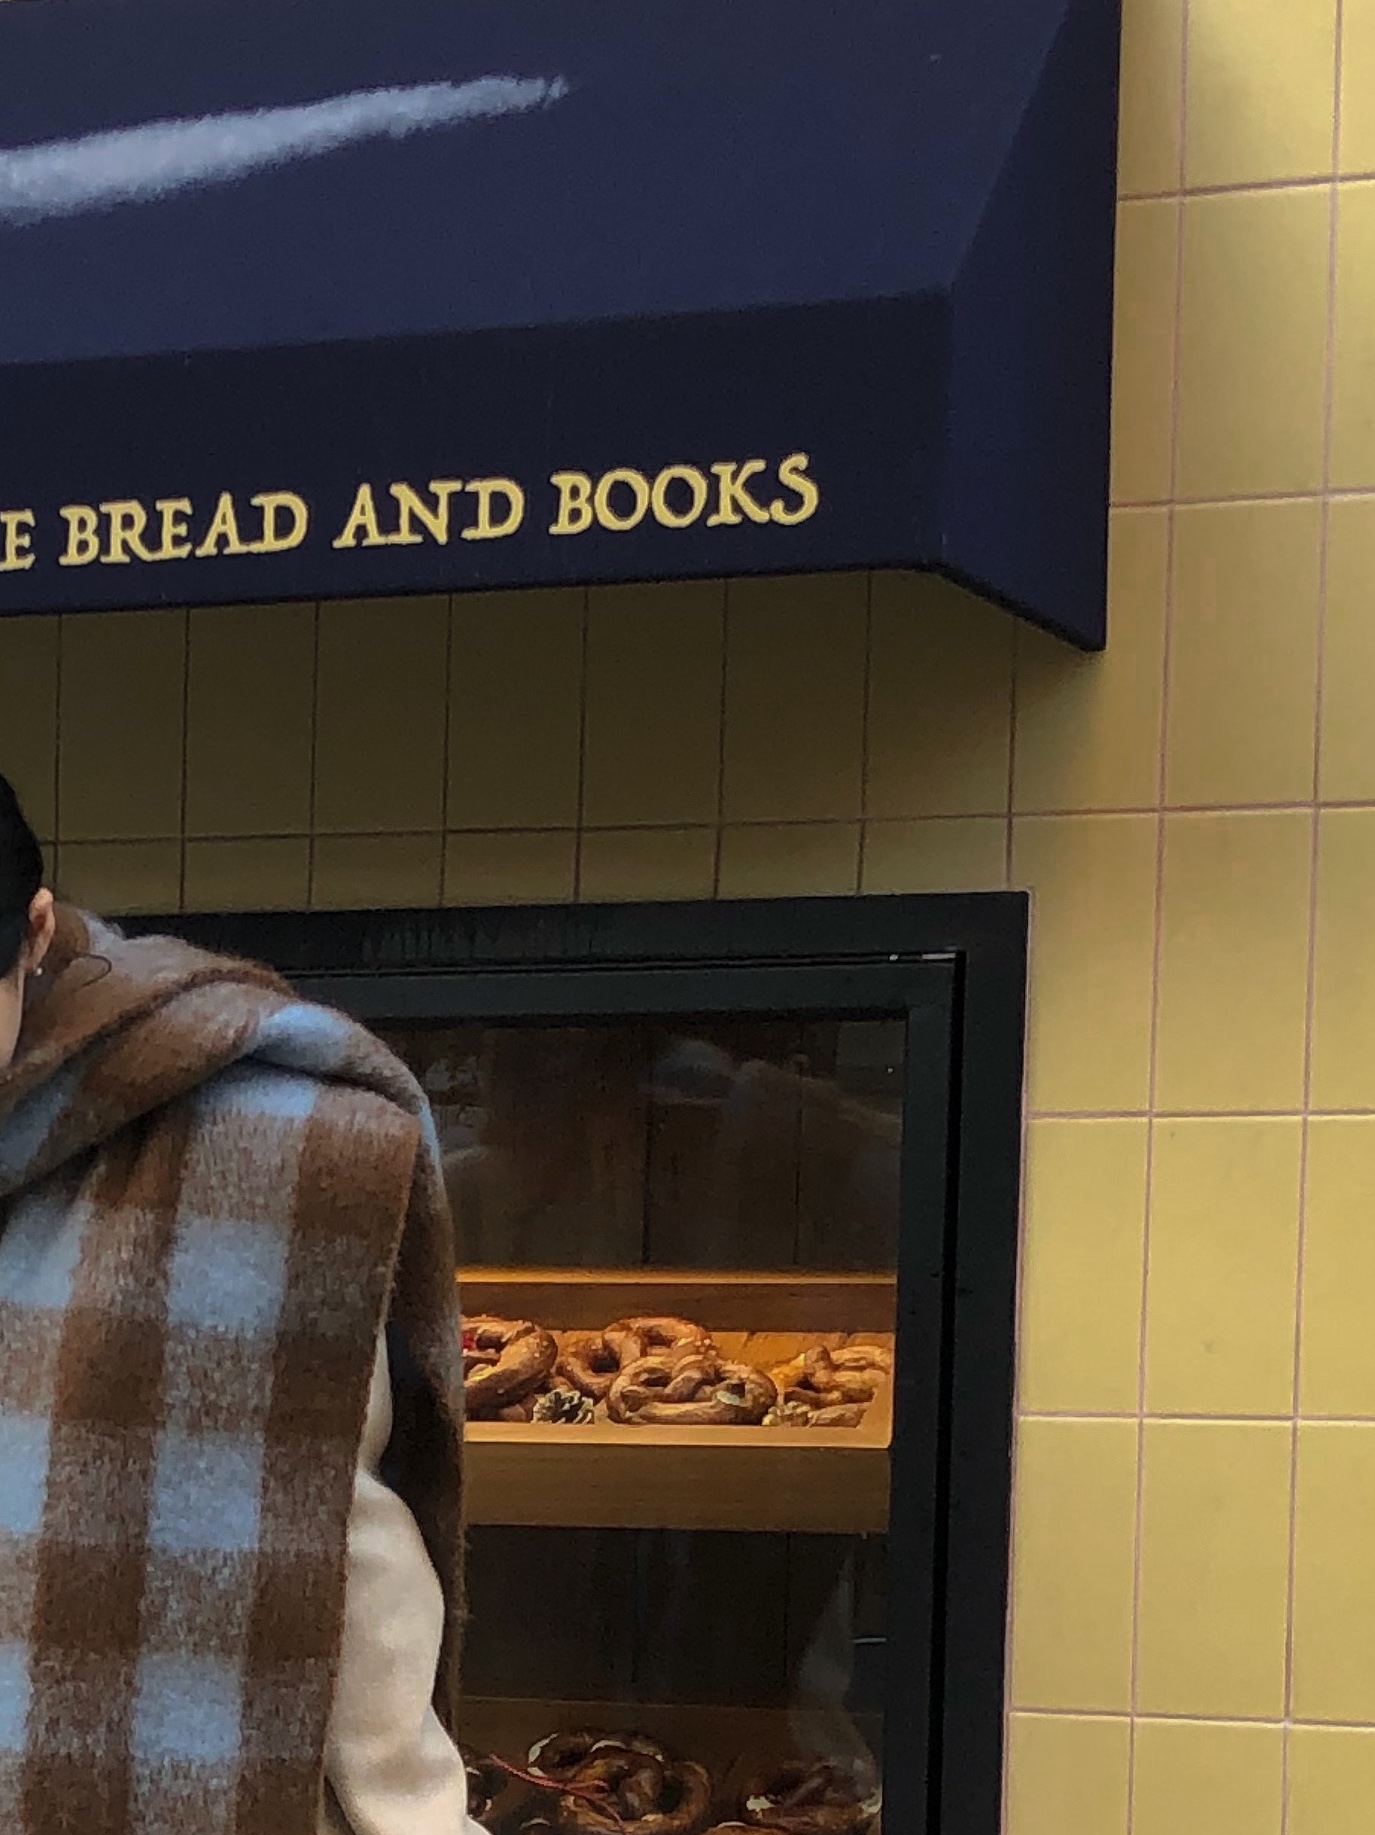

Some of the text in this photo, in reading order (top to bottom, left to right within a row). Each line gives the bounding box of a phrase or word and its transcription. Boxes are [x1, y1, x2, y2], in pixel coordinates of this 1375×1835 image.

[59, 491, 309, 566] BREAD
[333, 478, 525, 549] AND
[549, 453, 819, 536] BOOKS
